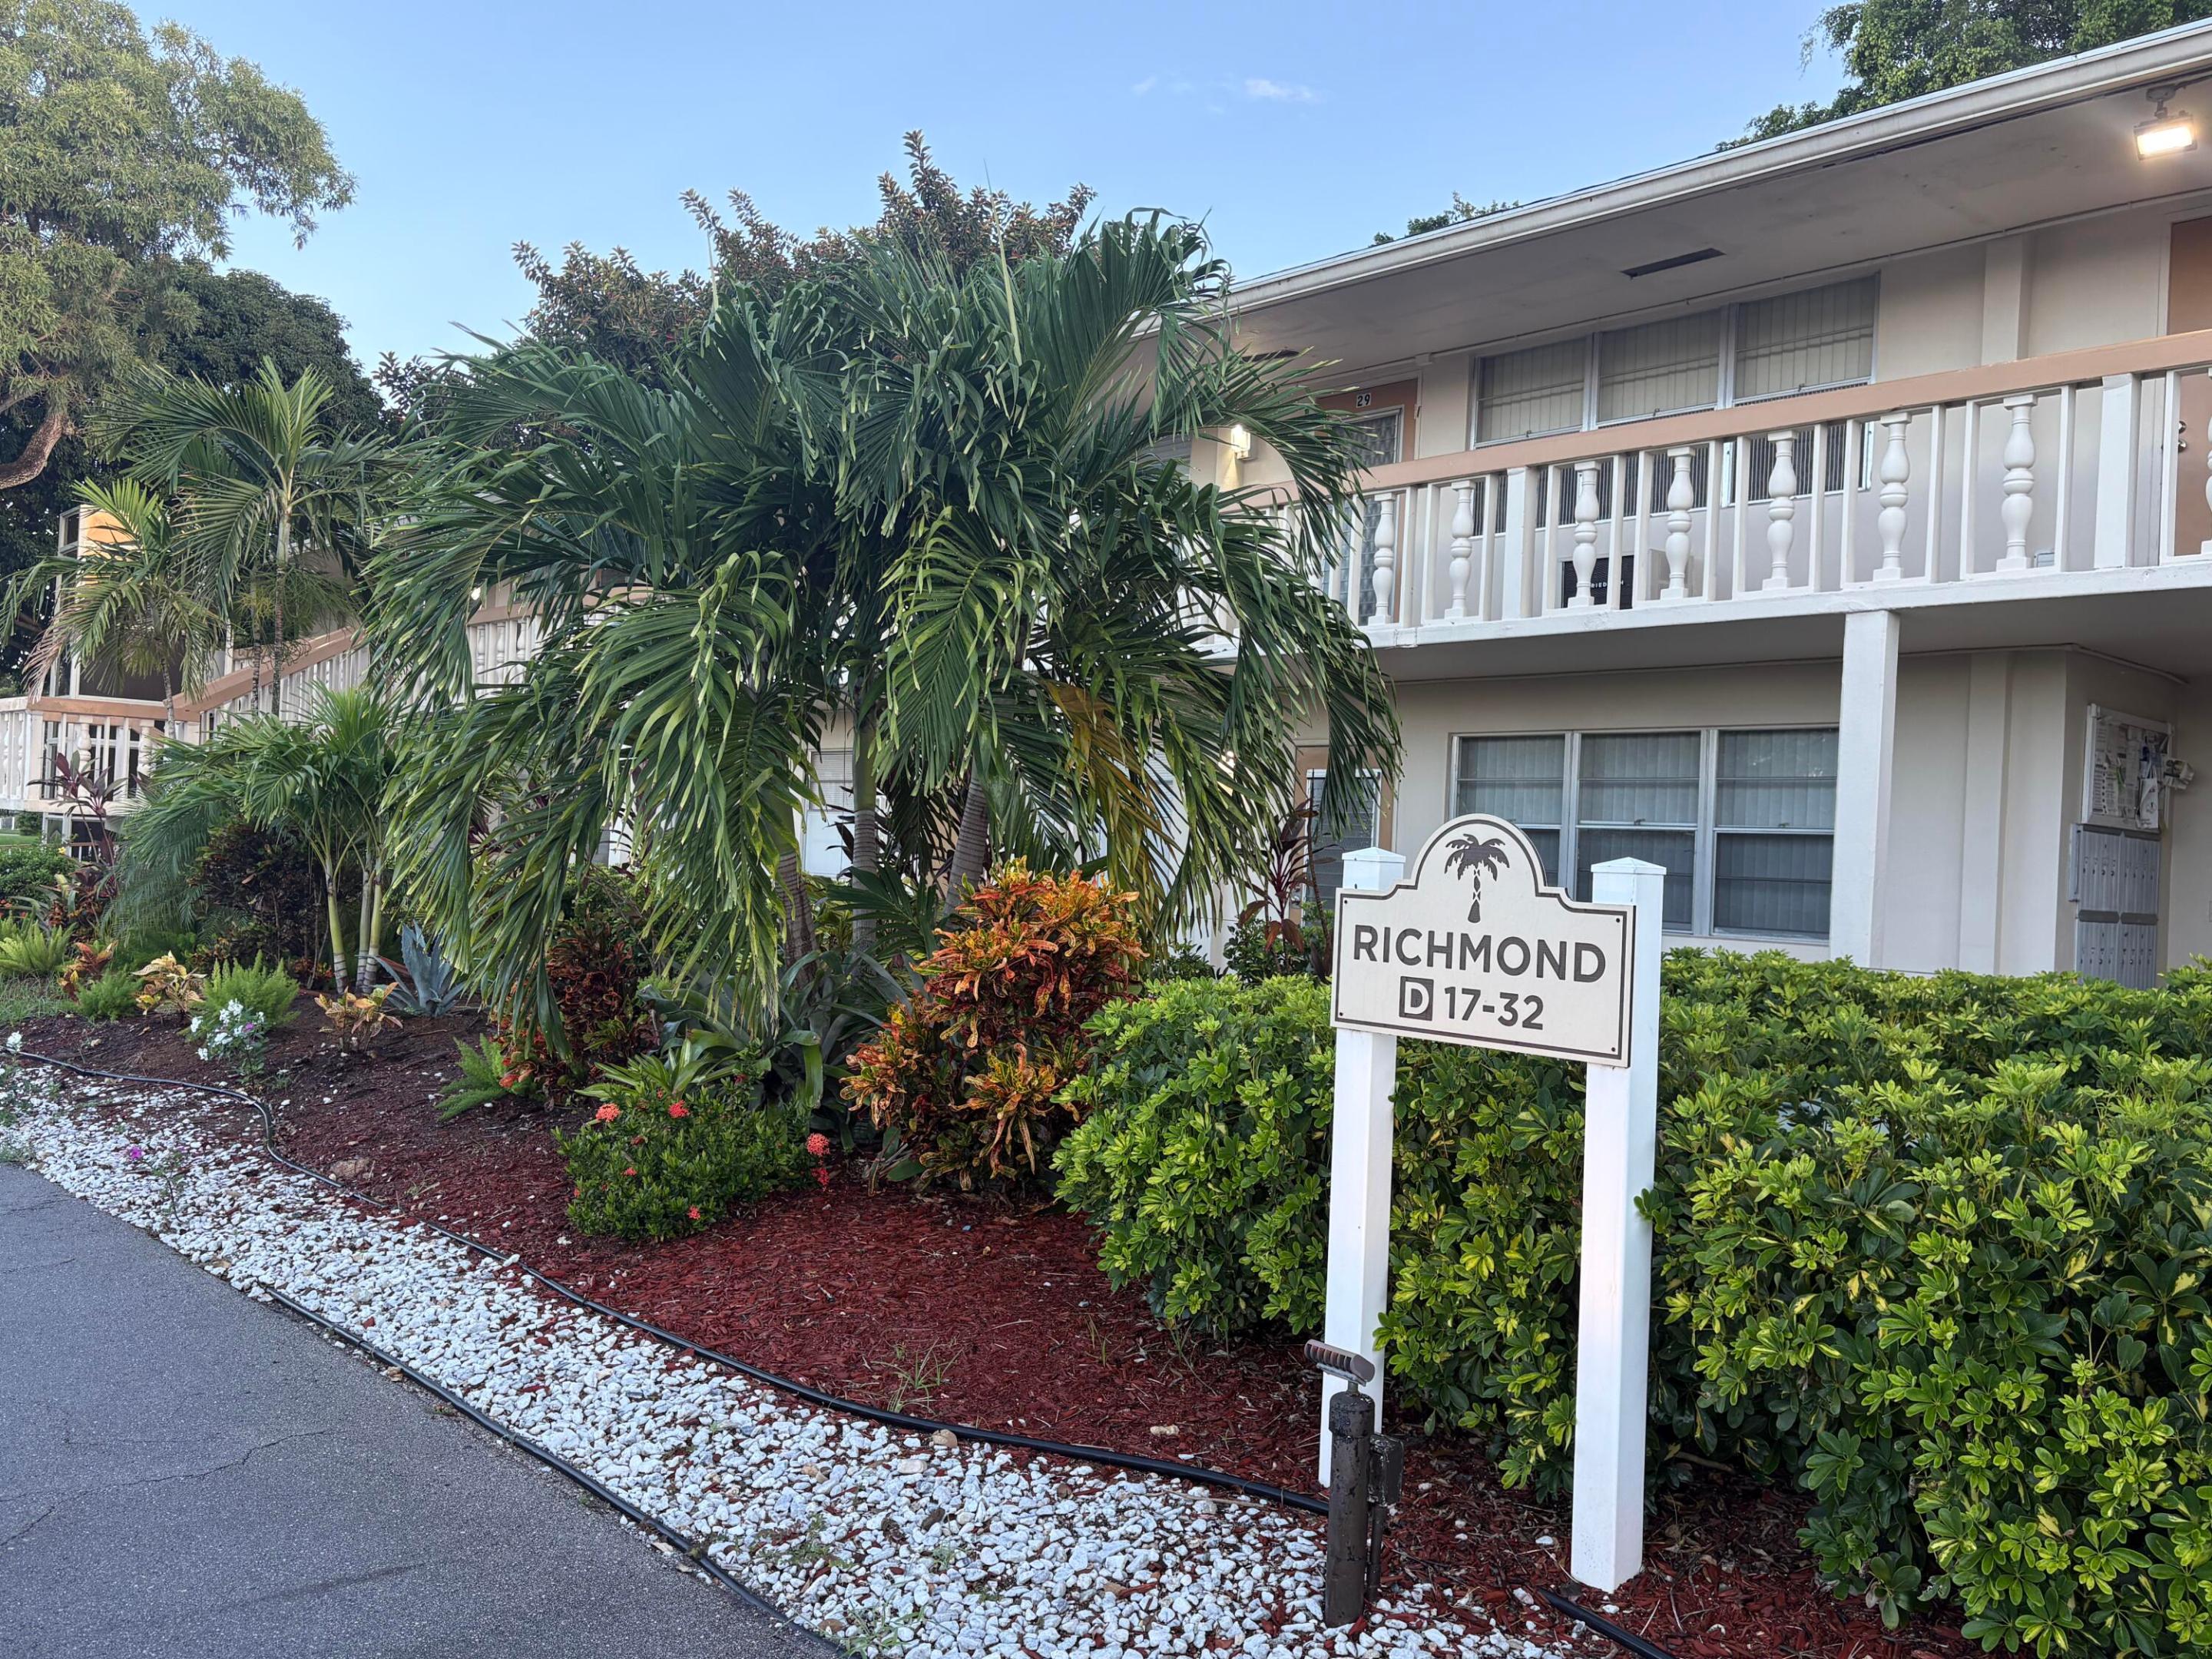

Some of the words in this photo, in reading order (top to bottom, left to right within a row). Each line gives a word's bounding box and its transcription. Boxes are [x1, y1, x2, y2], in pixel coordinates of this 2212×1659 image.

[1357, 394, 1370, 407] 29
[1353, 924, 1606, 983] RICHMOND
[1403, 981, 1430, 1015] D
[1444, 985, 1544, 1031] 17-32
